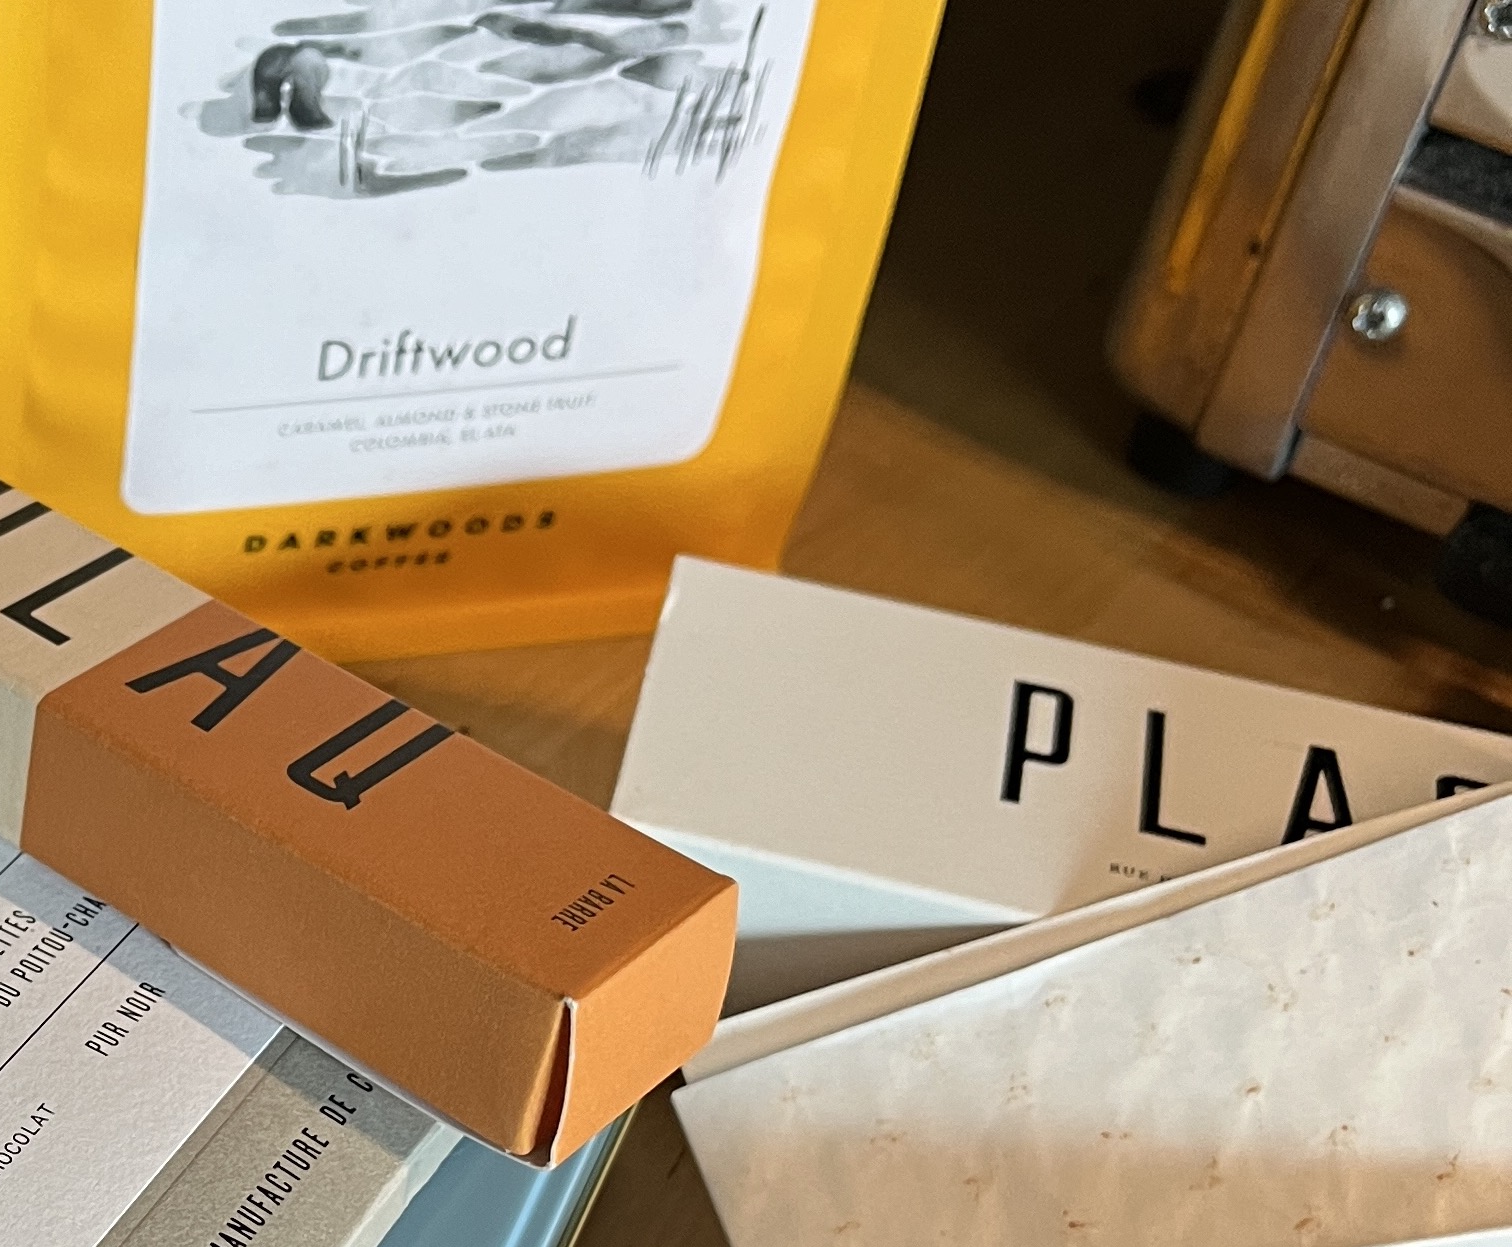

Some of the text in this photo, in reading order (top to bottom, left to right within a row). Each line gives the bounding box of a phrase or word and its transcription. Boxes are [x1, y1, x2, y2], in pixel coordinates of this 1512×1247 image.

[316, 313, 578, 383] Driftwood
[244, 510, 556, 555] DARKWOODS
[326, 550, 452, 575] COFFEE
[999, 678, 1488, 846] PLA
[550, 873, 636, 933] LA BARRE
[85, 979, 167, 1057] PUR NOIR
[319, 1093, 358, 1127] DE
